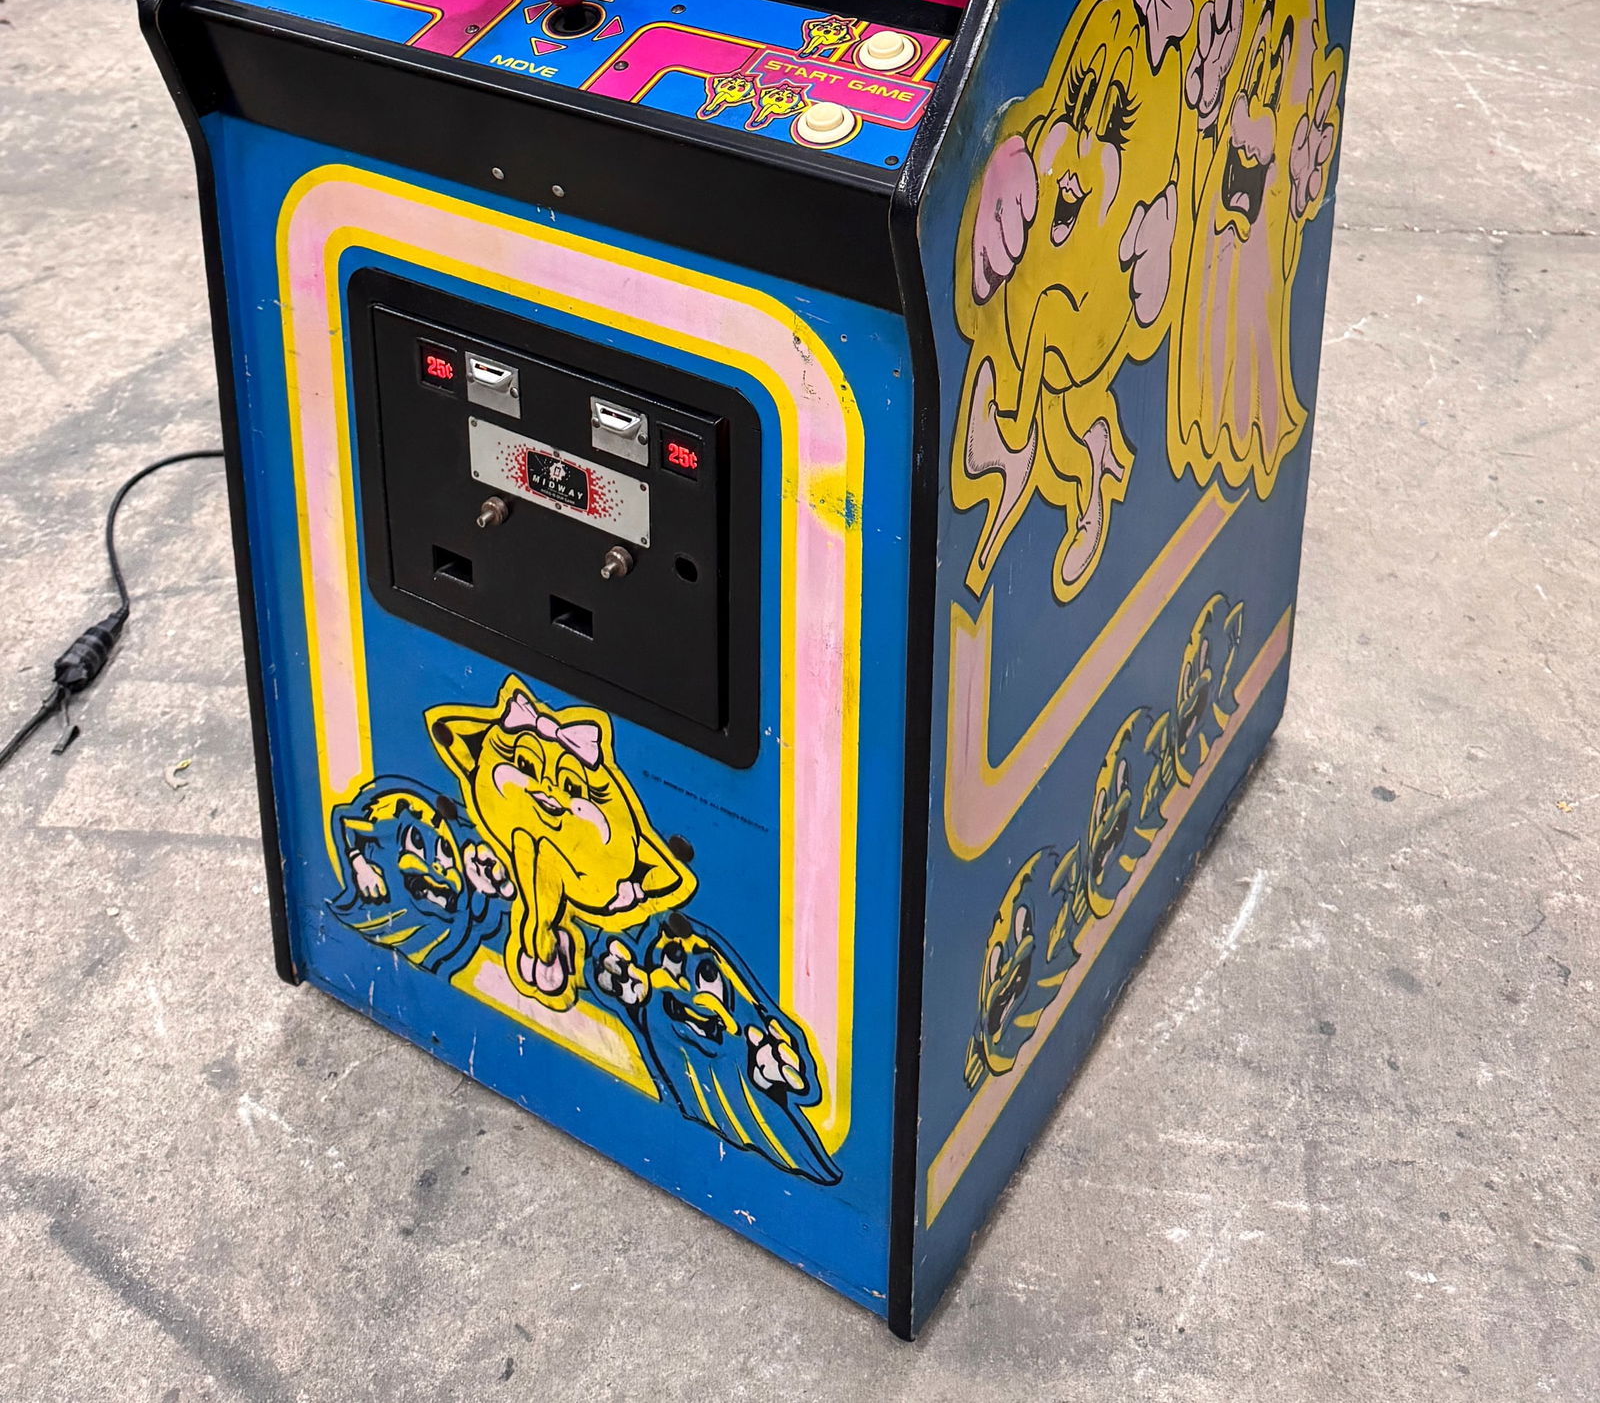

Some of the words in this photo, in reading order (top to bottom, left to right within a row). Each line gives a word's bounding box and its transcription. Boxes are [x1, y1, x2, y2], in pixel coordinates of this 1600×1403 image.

[489, 54, 559, 78] MOVE
[764, 59, 844, 85] START
[847, 79, 915, 102] GAME
[426, 355, 454, 379] 25¢
[667, 443, 698, 469] 25¢
[532, 474, 584, 500] MIDWAY
